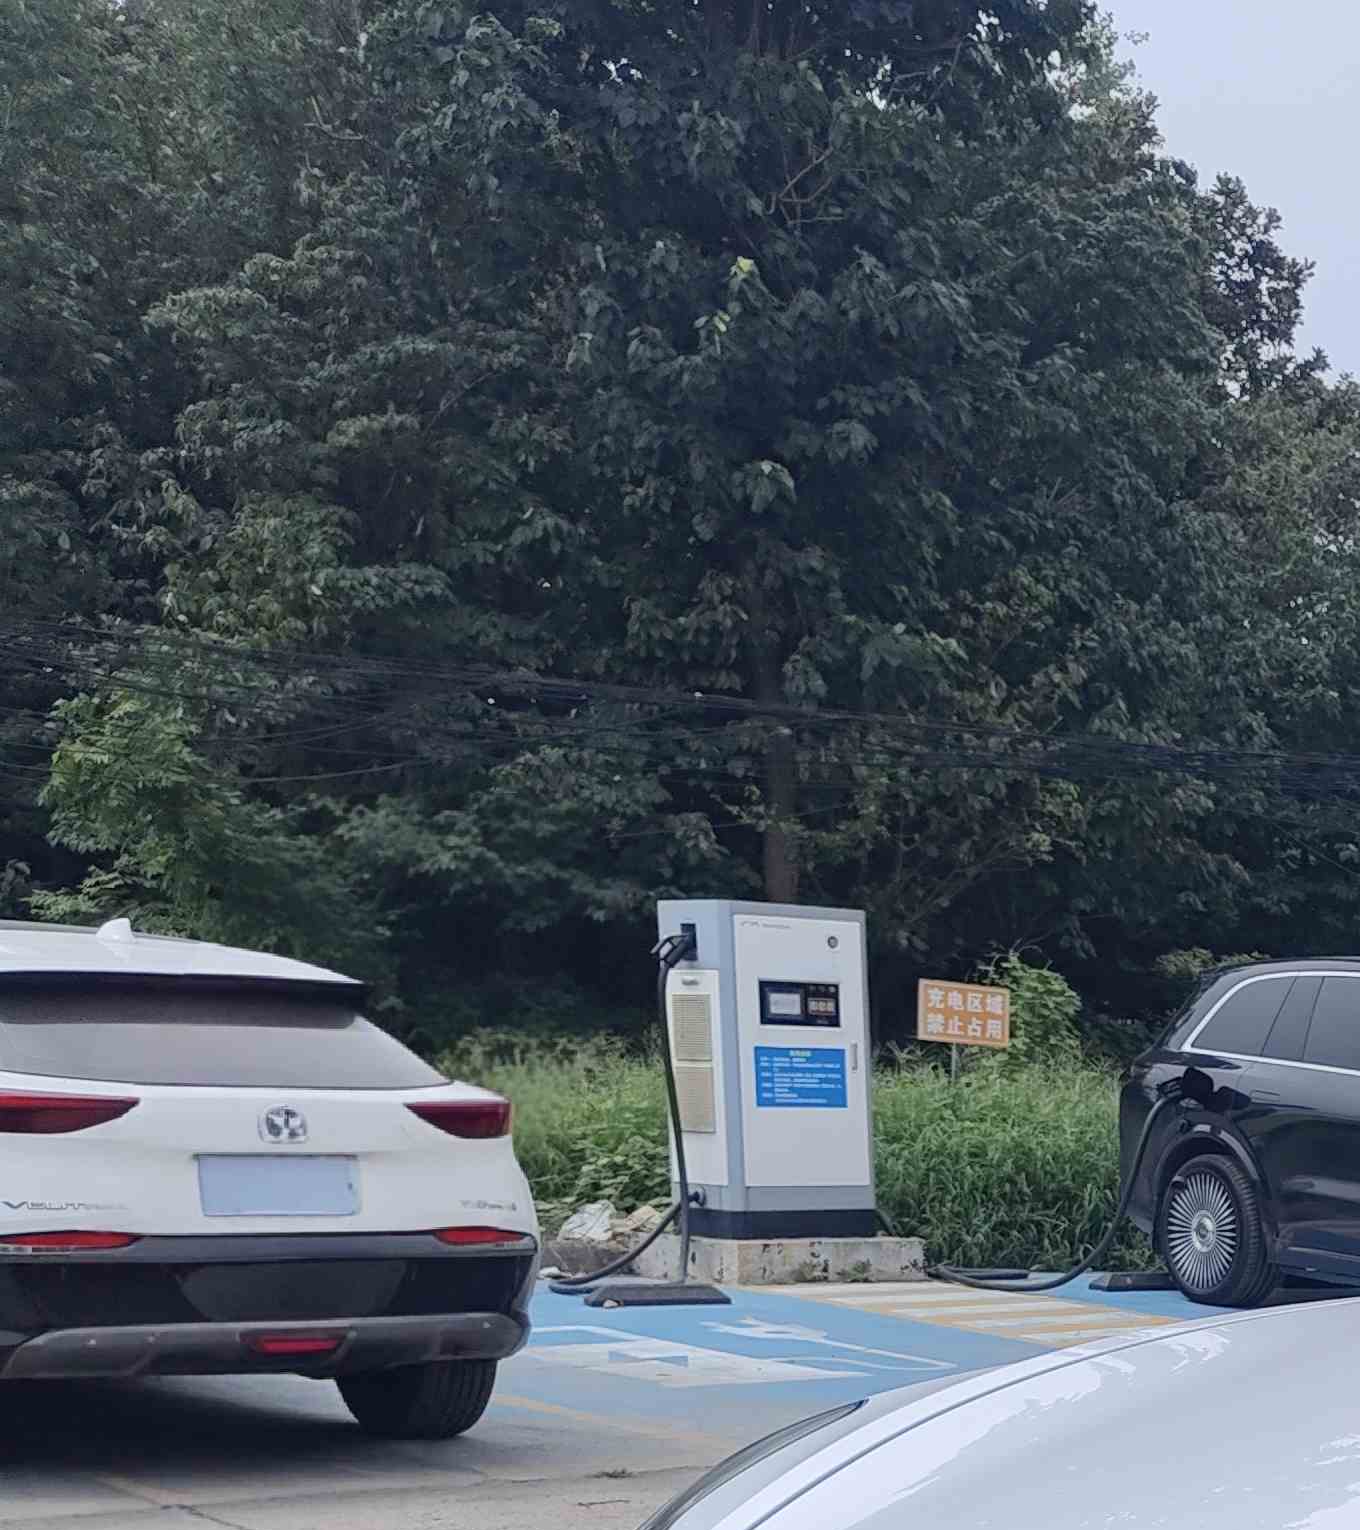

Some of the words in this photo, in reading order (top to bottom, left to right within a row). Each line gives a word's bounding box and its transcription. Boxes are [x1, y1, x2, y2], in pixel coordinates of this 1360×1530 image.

[927, 986, 1004, 1014] 充电区域
[927, 1013, 1002, 1039] 禁止占用
